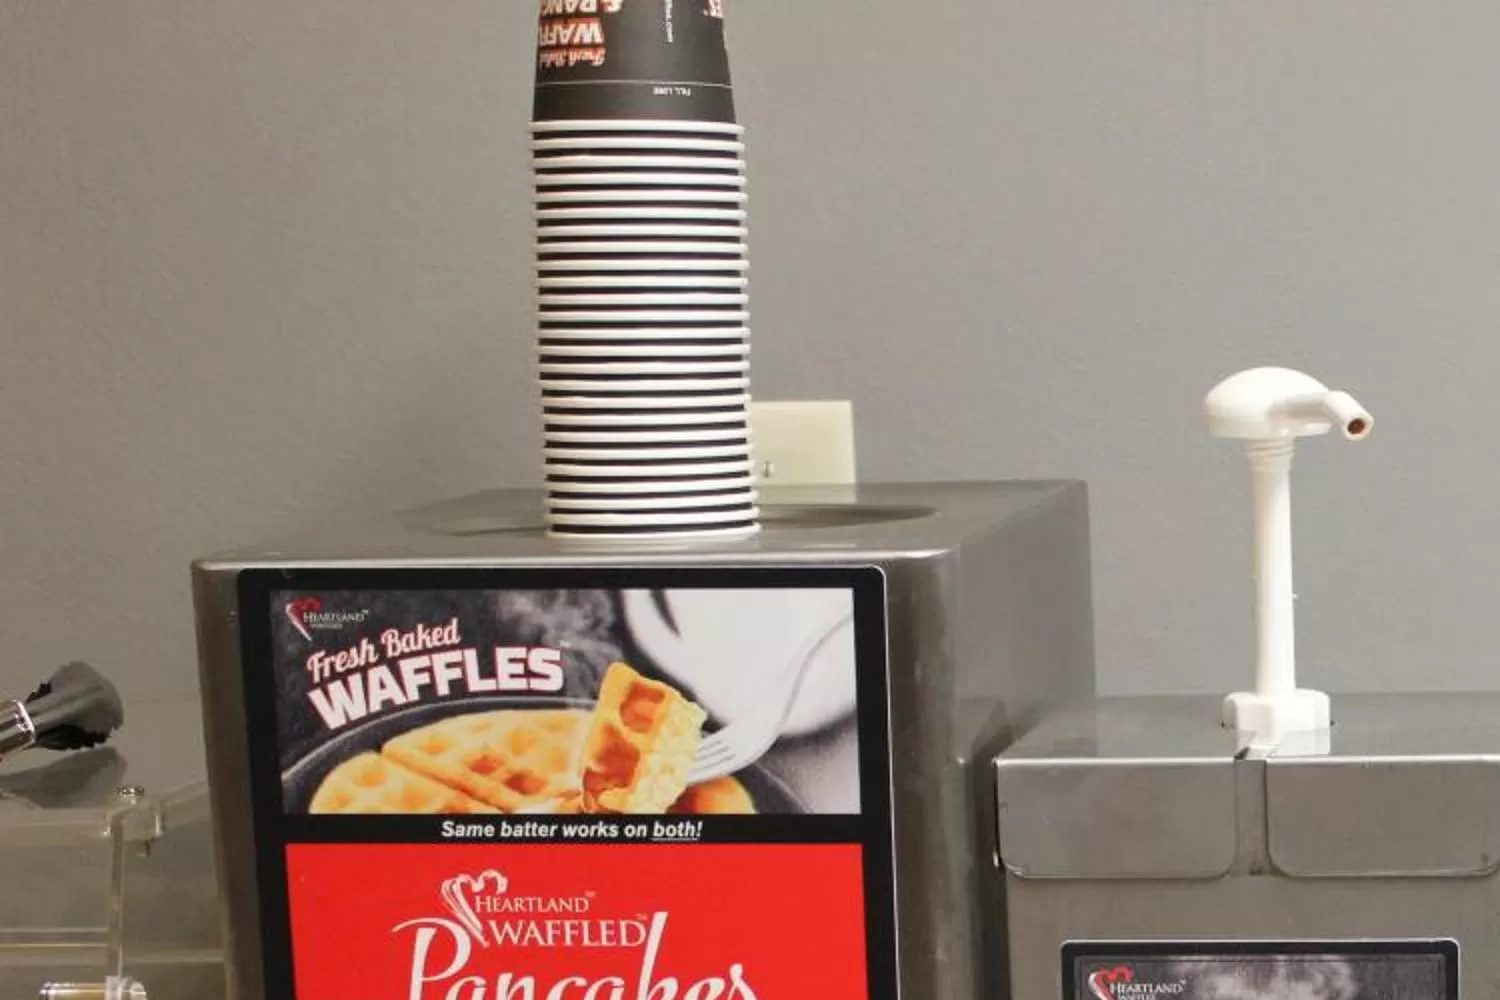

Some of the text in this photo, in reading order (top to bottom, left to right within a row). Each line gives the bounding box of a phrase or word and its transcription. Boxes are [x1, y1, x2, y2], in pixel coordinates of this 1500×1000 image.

[306, 617, 462, 684] Fresh Baked
[307, 646, 564, 730] WAFFLES
[441, 820, 703, 839] Same batter works on both!
[474, 894, 589, 914] HEARTLAND
[488, 919, 648, 947] WAFFLED
[1110, 982, 1184, 995] HEARTLAND
